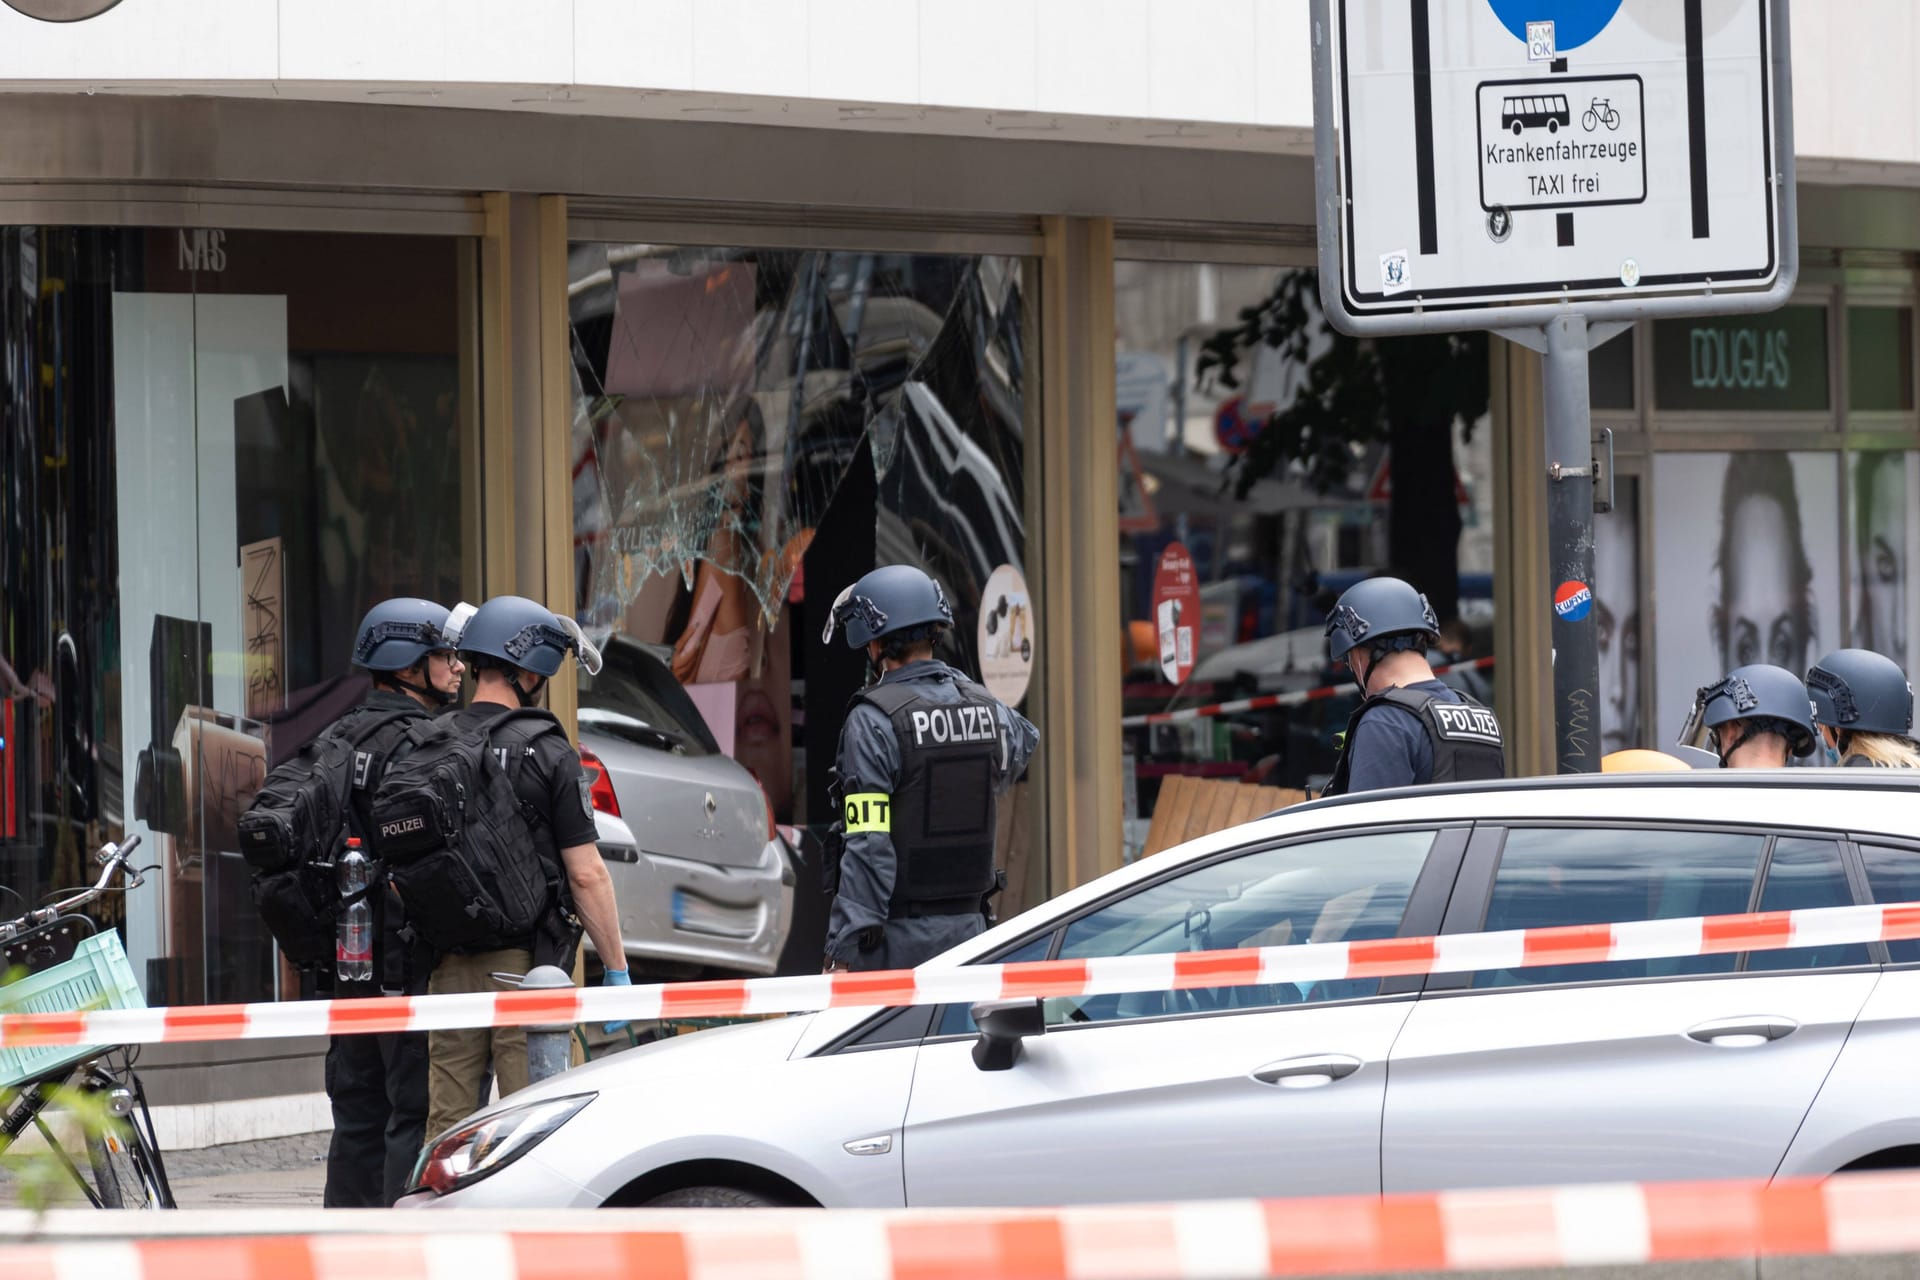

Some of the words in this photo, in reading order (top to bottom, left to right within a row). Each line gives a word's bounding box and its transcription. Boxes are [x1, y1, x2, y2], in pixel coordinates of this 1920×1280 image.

[1532, 42, 1552, 57] OK
[1486, 139, 1638, 165] Krankenfahrzeuge
[1527, 173, 1565, 197] TAXI
[1572, 172, 1600, 194] frei
[1690, 327, 1791, 389] DOUGLAS
[911, 706, 997, 745] POLIZEI
[1437, 709, 1500, 737] POLIZEI
[845, 800, 890, 826] QIT
[381, 817, 425, 838] POLIZEI
